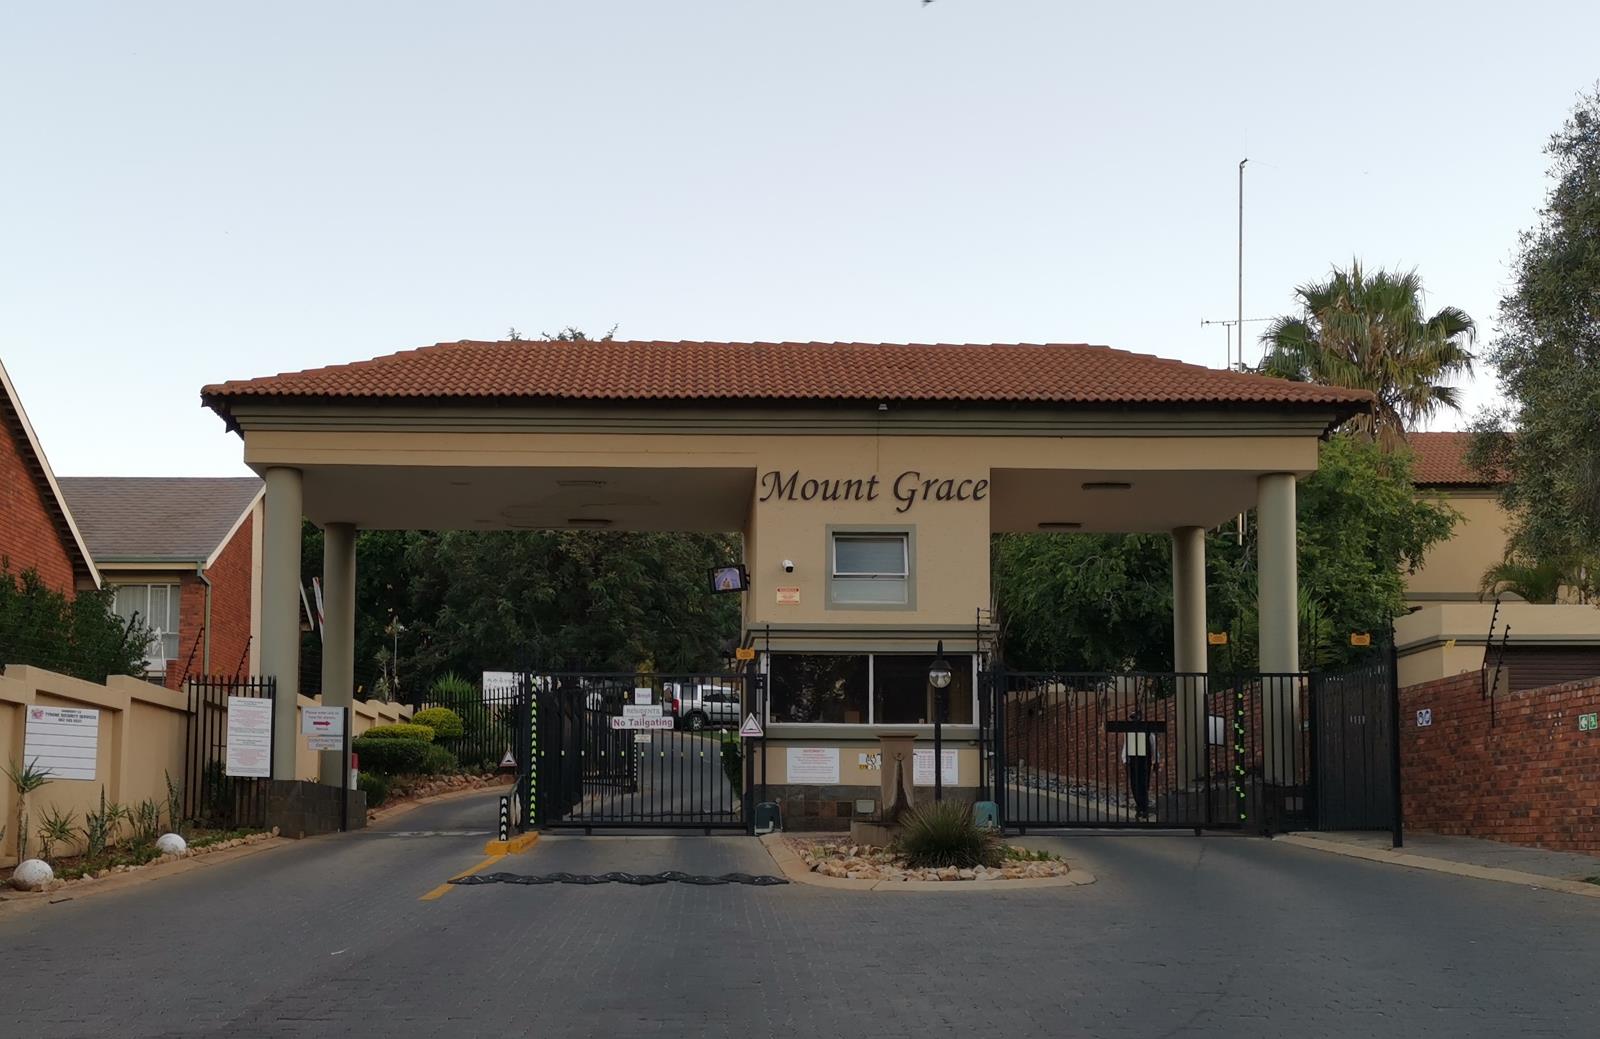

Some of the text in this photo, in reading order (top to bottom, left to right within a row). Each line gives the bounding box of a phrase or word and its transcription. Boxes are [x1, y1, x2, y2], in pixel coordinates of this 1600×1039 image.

[759, 469, 988, 513] Mount Grace
[613, 718, 673, 728] No Tailgating
